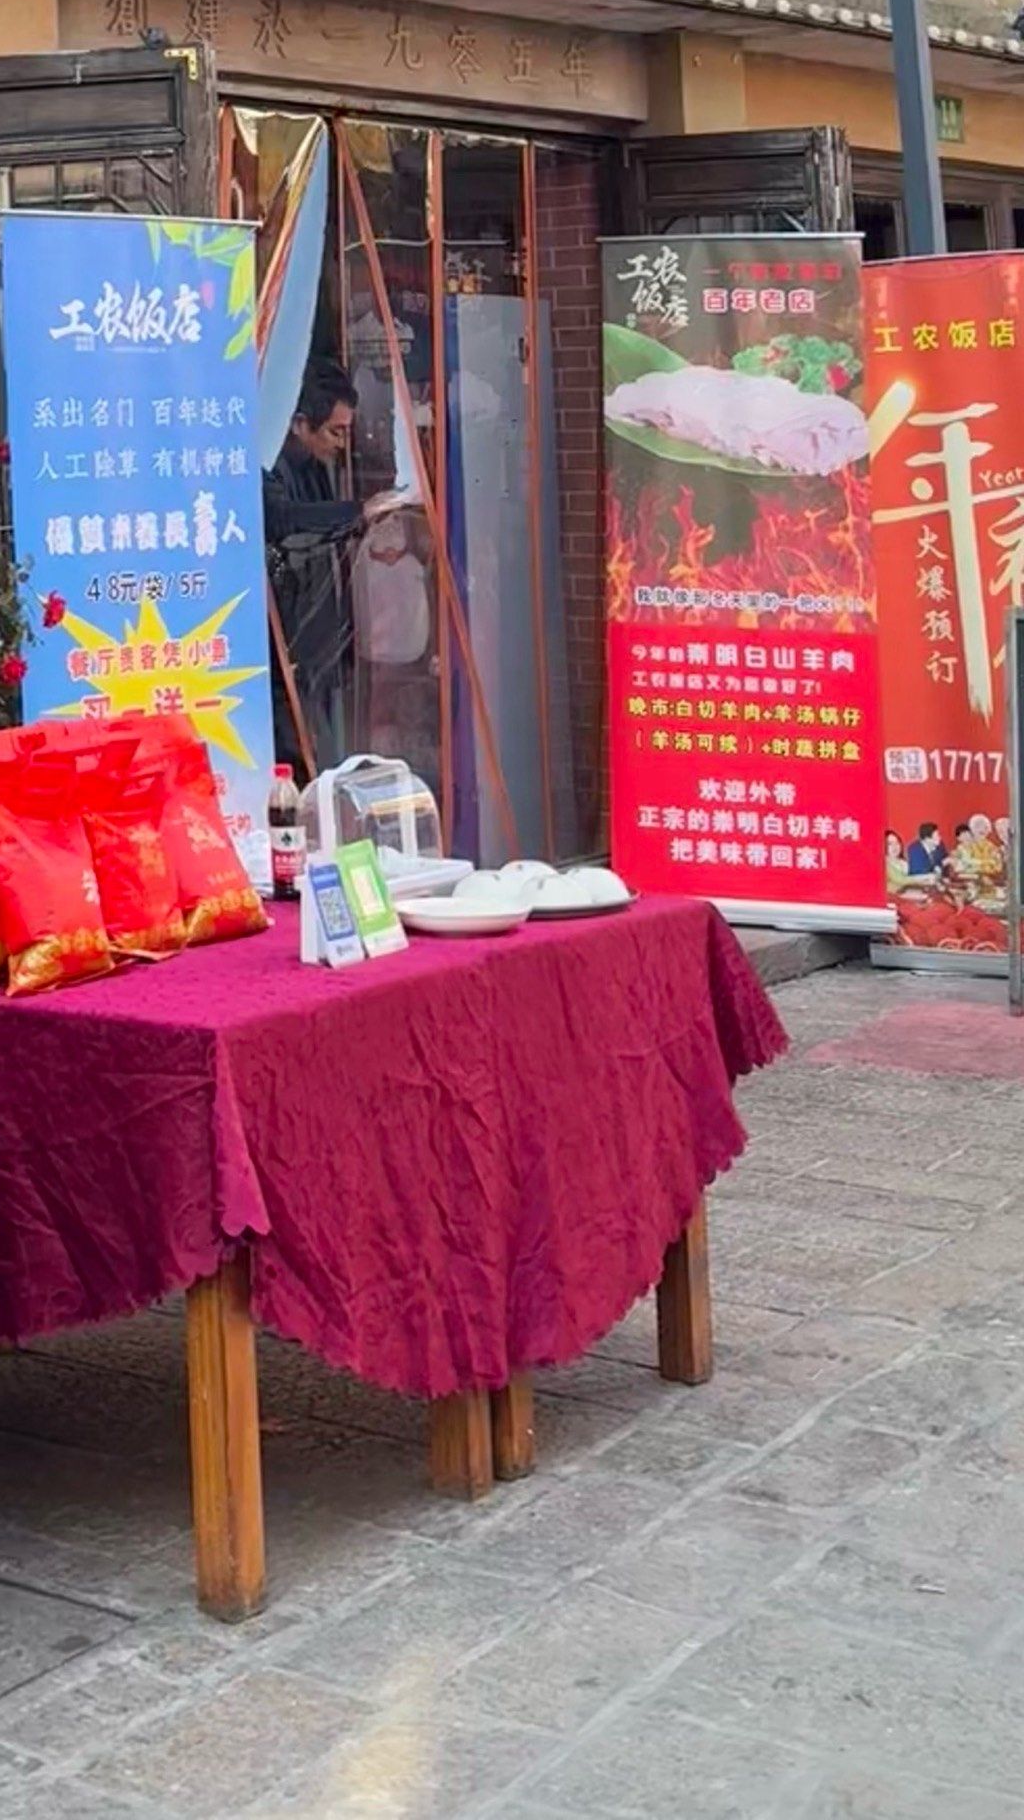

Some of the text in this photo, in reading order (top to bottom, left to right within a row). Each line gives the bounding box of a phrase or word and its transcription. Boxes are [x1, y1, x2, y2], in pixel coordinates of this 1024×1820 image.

[49, 281, 202, 344] 工农饭店
[703, 288, 815, 313] 百年老店
[874, 319, 1016, 352] 工农饭店
[33, 397, 134, 428] 系出名门
[36, 446, 251, 480] 人工除草 有机种植
[915, 525, 958, 684] 火爆预订
[929, 748, 1012, 783] 17717
[699, 779, 797, 806] 欢迎外带
[638, 806, 861, 842] 正宗的崇明白切羊肉
